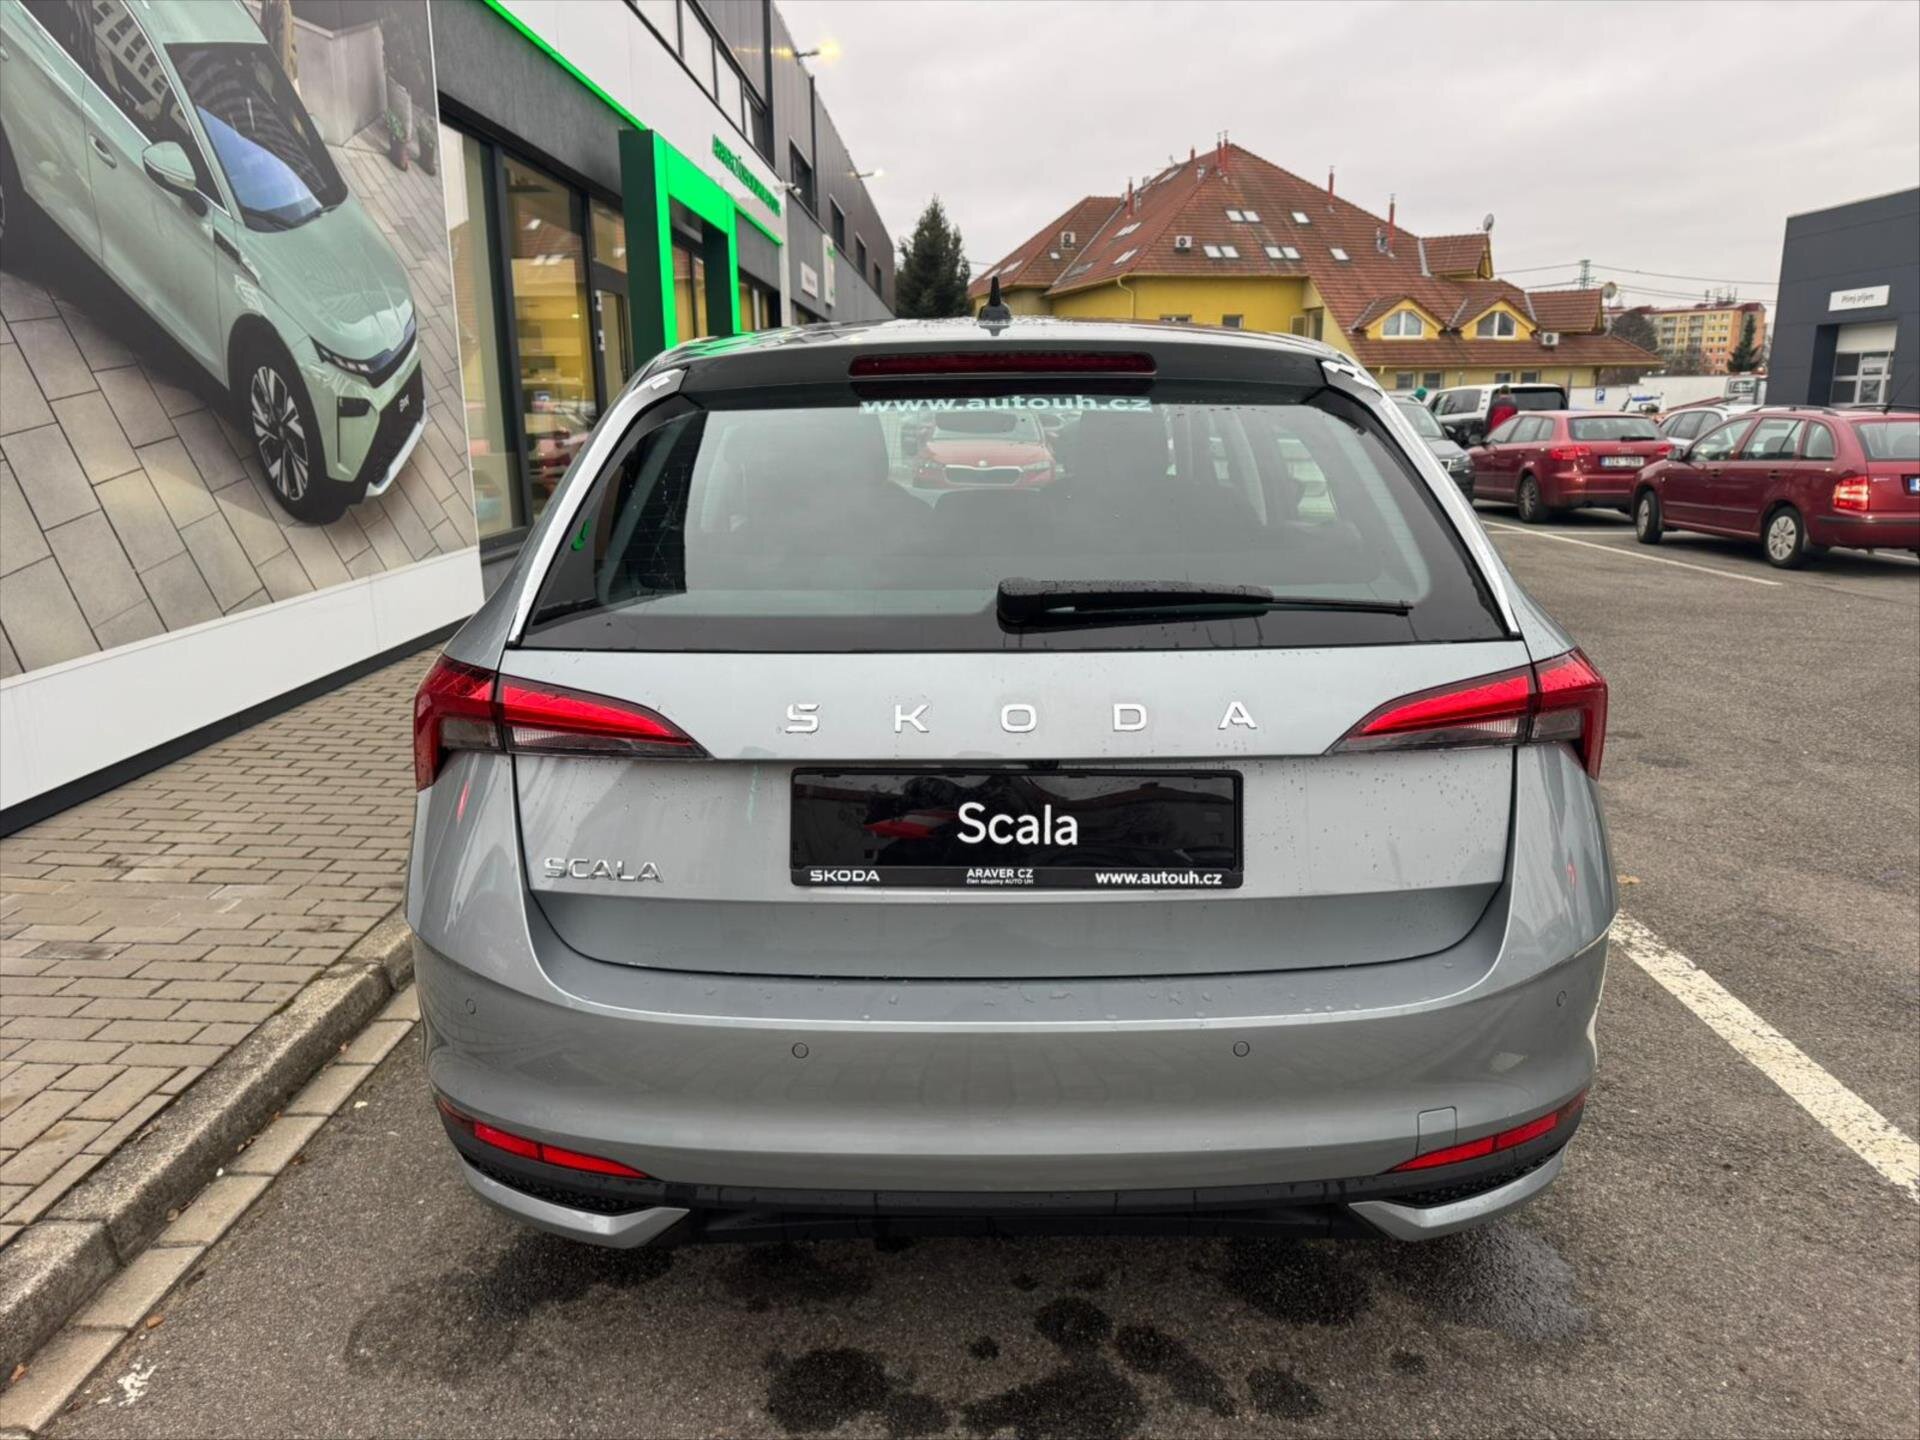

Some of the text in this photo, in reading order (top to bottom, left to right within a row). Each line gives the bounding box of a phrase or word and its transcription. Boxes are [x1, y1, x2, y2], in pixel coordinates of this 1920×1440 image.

[861, 395, 1152, 413] www.autouh.cz
[957, 801, 1078, 846] Scala
[544, 857, 664, 882] SCALA
[966, 868, 1033, 878] ARAVER CZ
[1095, 870, 1222, 885] www.autouh.cz
